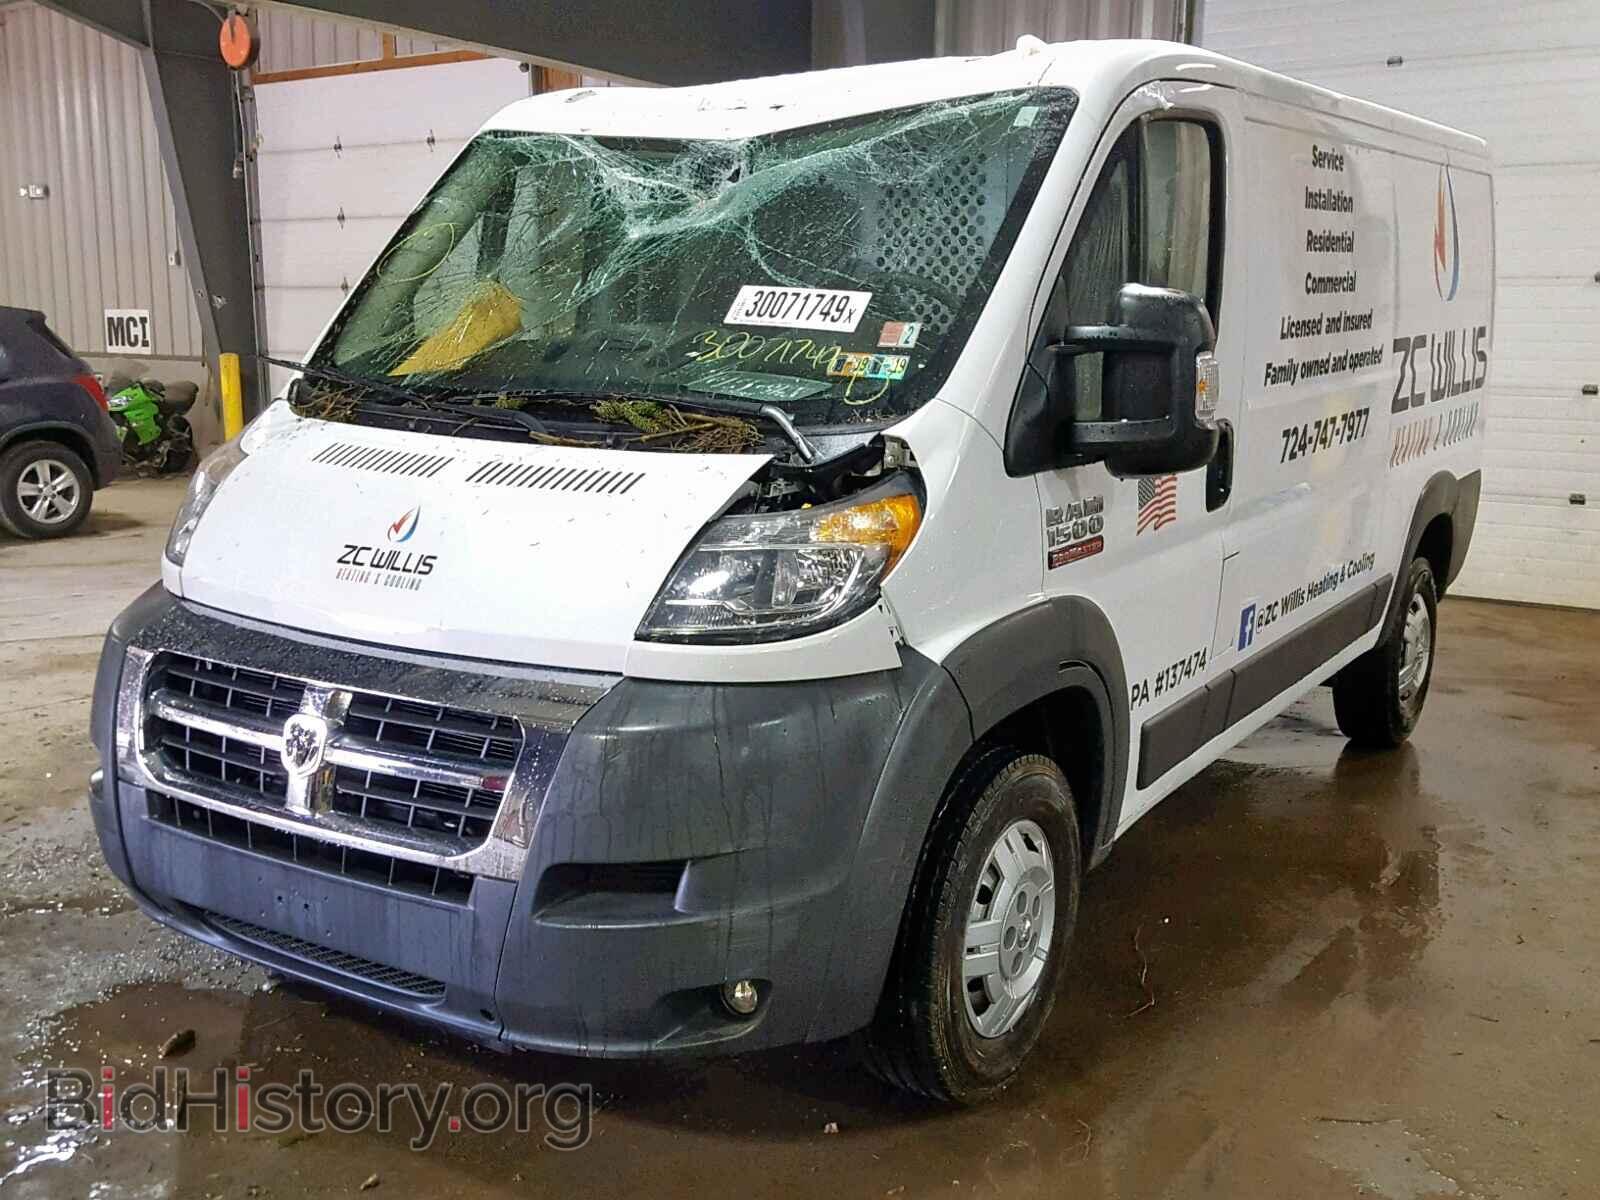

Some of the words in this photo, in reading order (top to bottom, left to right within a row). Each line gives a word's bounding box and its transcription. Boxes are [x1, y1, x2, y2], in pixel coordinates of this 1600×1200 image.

[1312, 145, 1344, 172] Service
[1304, 186, 1354, 213] Installation
[1306, 229, 1355, 253] Residential
[1305, 271, 1357, 295] Commercial
[106, 316, 150, 348] MCI
[903, 325, 915, 345] 2
[1280, 312, 1323, 340] Licensed
[1325, 311, 1343, 335] and
[1342, 308, 1373, 332] insured
[1264, 358, 1300, 387] Family
[1300, 352, 1331, 379] owned
[1331, 349, 1349, 373] and
[1349, 344, 1384, 373] operated
[1391, 334, 1427, 414] ZC
[1430, 326, 1487, 402] WILLIS
[1280, 407, 1370, 464] 724-747-7977
[1046, 494, 1104, 528] RAM
[1046, 514, 1104, 547] 1500
[336, 544, 372, 566] ZC
[370, 548, 438, 575] WILLIS
[1280, 588, 1305, 617] Willis
[1306, 570, 1339, 603] Heating
[1339, 567, 1346, 583] &
[1347, 552, 1376, 578] Cooling
[1130, 678, 1150, 711] PA
[1154, 646, 1207, 698] #137474
